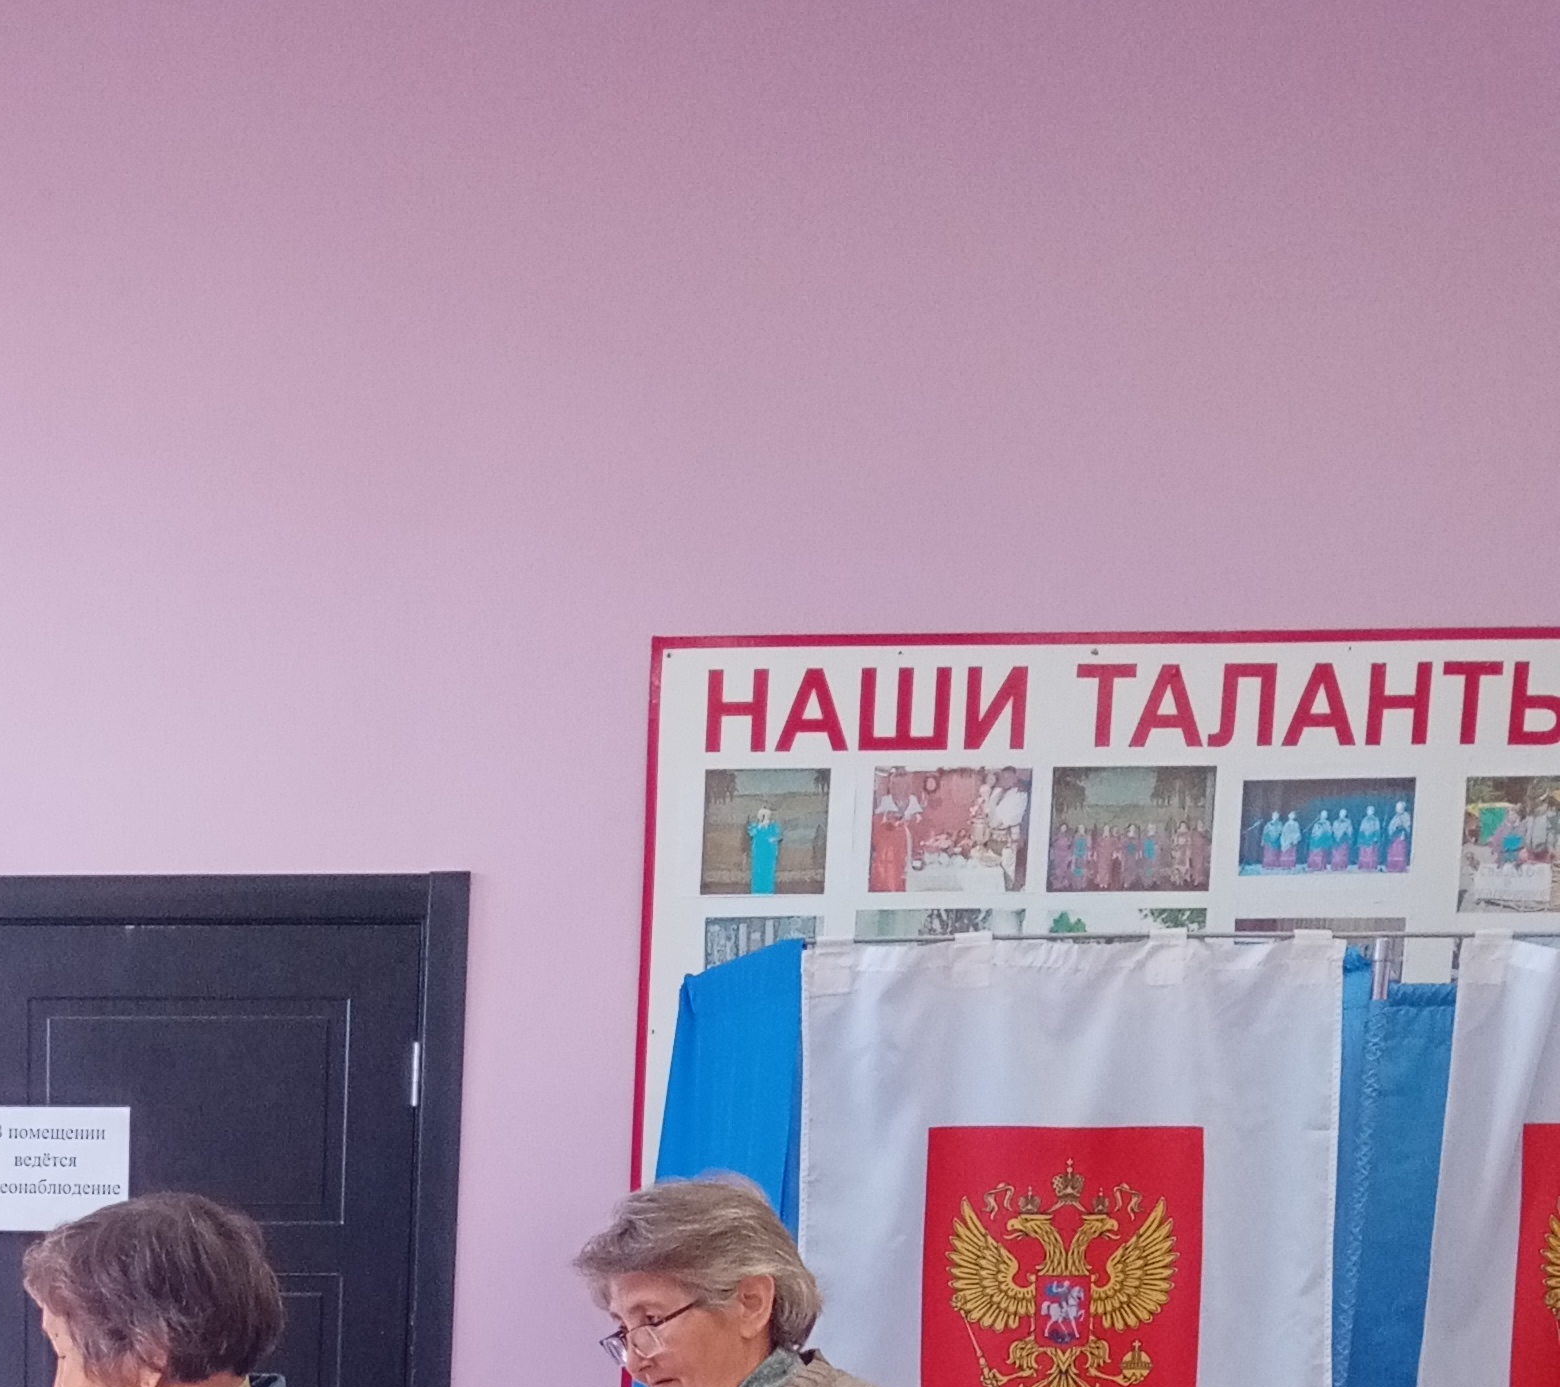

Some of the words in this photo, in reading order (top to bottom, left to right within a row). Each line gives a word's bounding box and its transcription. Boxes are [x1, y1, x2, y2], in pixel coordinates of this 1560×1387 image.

[704, 665, 1030, 753] НАШИ
[8, 1126, 105, 1141] помещении
[14, 1153, 77, 1168] ведётся
